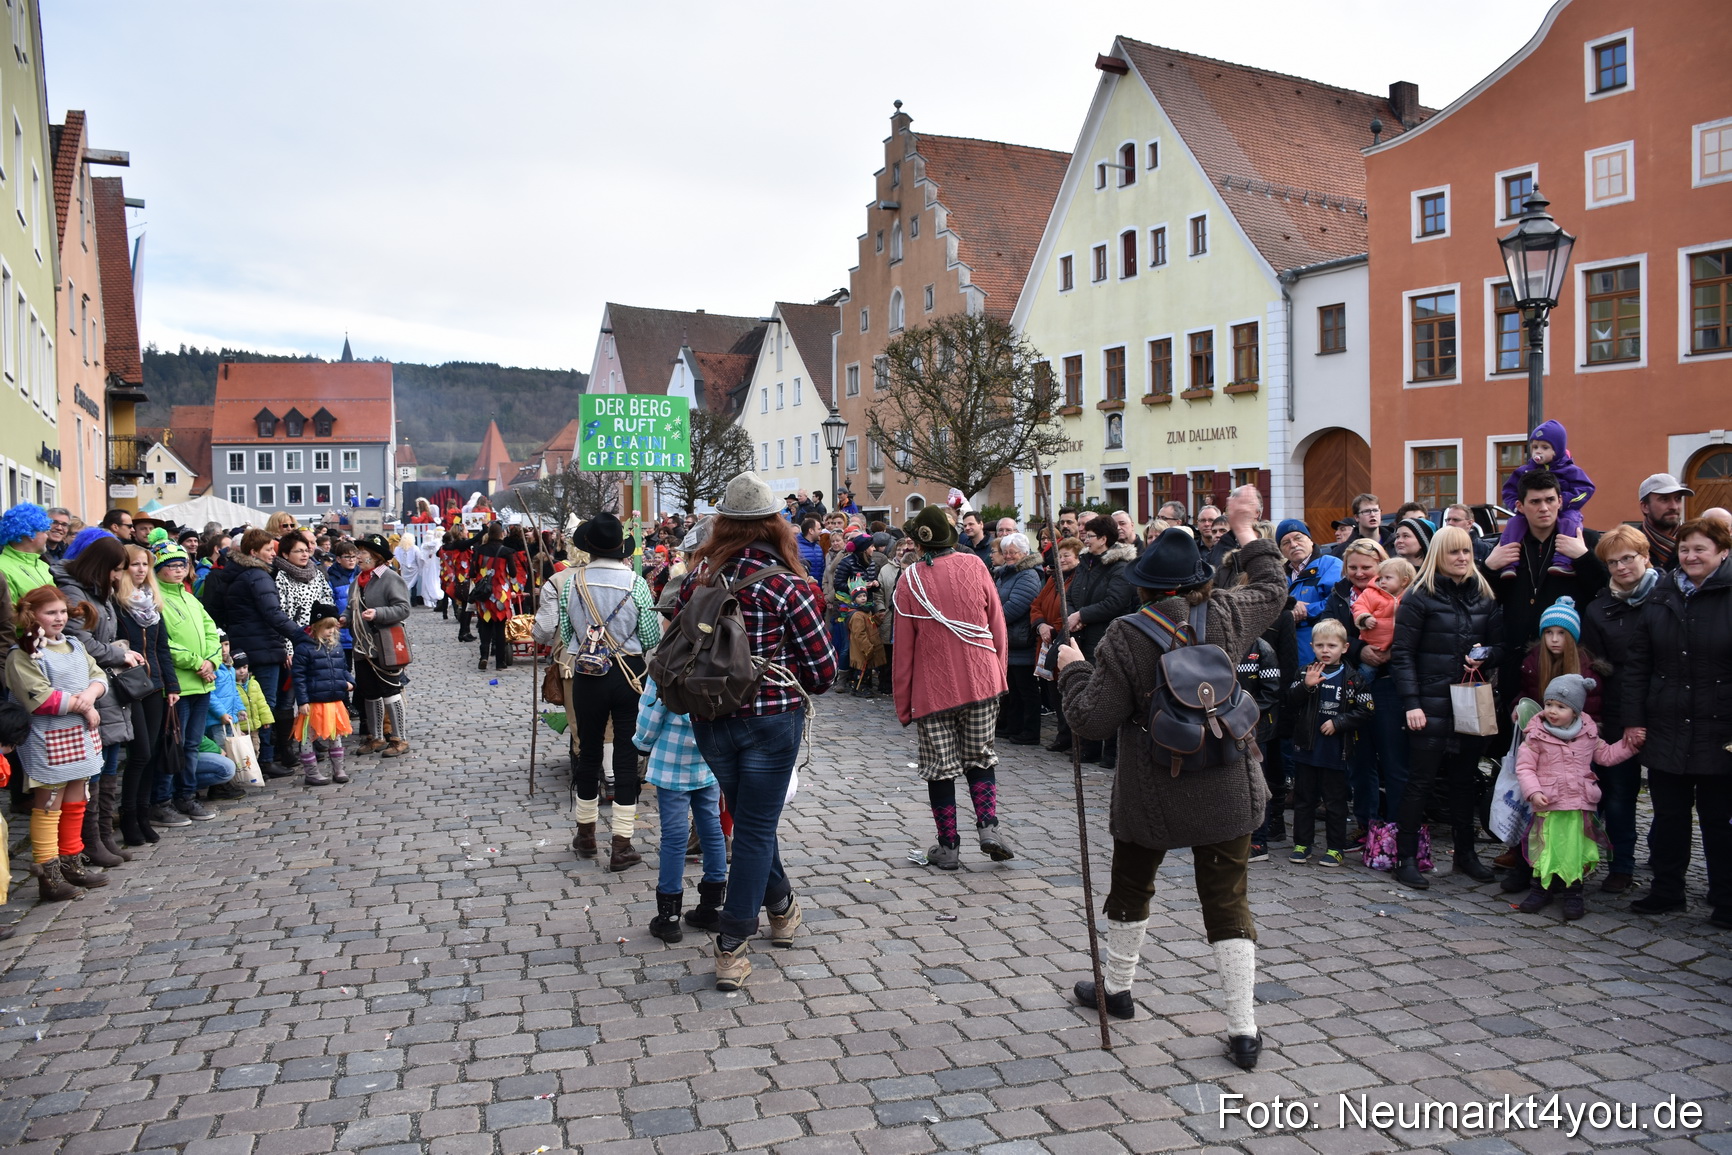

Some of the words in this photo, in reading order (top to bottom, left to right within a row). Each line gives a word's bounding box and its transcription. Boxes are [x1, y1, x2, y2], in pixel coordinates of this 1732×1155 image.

[595, 398, 625, 416] DER
[629, 398, 671, 417] BERG
[613, 418, 656, 433] RUFT
[597, 434, 666, 450] BACHAMINI
[1166, 431, 1186, 444] ZUM
[1189, 426, 1238, 442] DALLMAYR
[587, 451, 685, 467] GIPFELSTÜRMER
